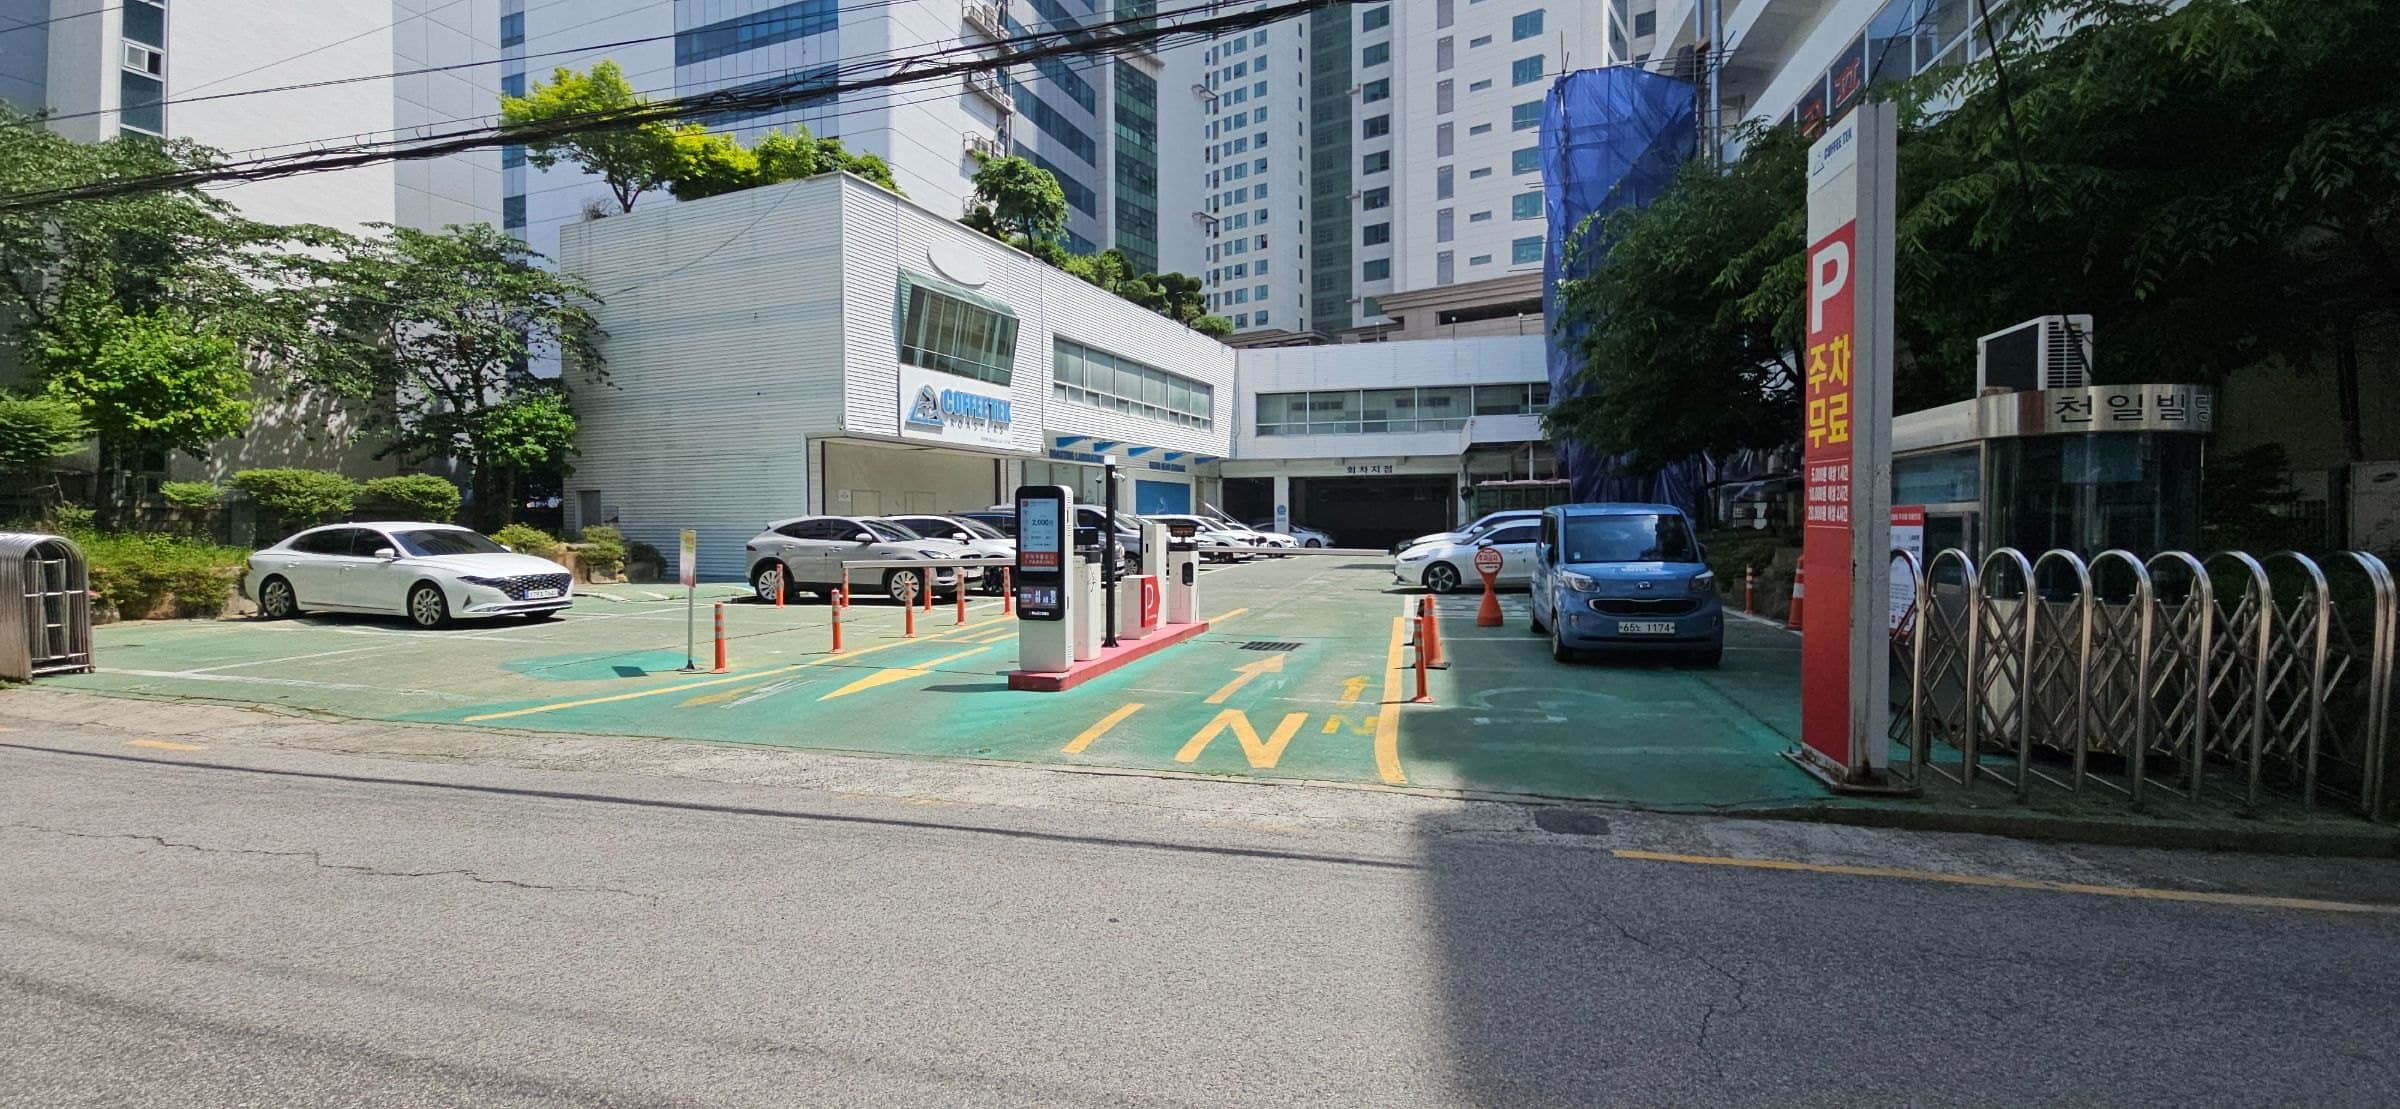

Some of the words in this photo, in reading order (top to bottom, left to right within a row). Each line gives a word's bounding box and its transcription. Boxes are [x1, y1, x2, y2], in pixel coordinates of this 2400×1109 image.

[1811, 240, 1849, 334] P
[1808, 334, 1850, 394] 주차
[1808, 392, 1848, 449] 무료
[2054, 394, 2211, 424] 천일빌딩
[1647, 623, 1670, 632] 1174
